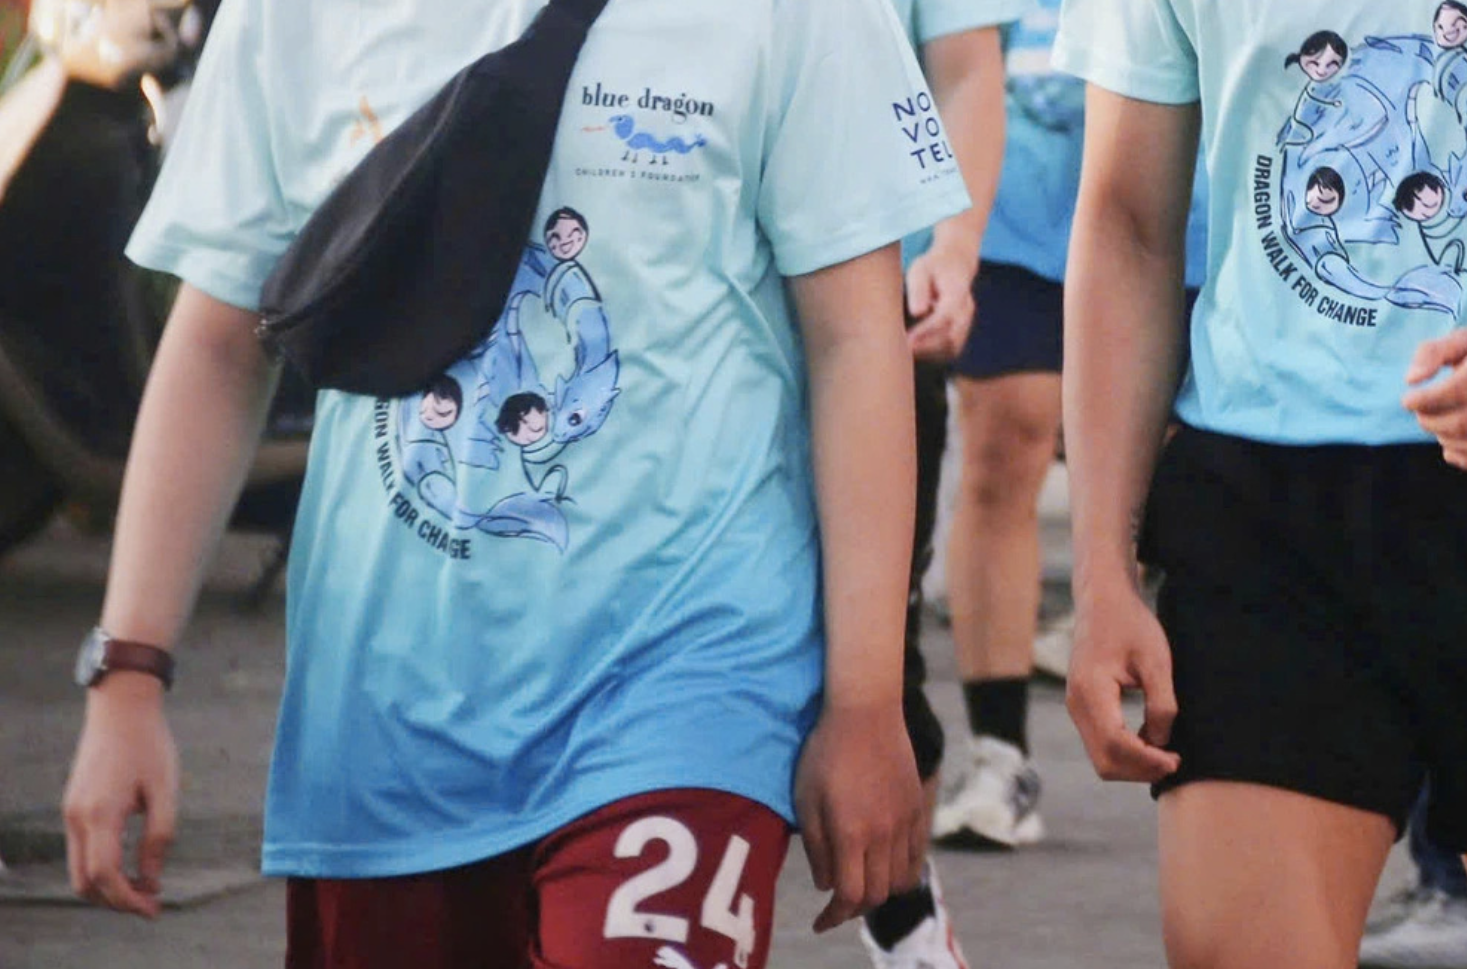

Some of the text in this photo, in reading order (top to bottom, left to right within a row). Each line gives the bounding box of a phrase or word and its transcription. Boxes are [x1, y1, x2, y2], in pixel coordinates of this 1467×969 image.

[582, 82, 714, 125] blue dragon
[892, 91, 932, 122] NO
[902, 117, 940, 143] VO
[1253, 154, 1378, 327] DRAGON WALK FOR CHANGE
[389, 491, 419, 529] FOR
[603, 815, 757, 968] 24
